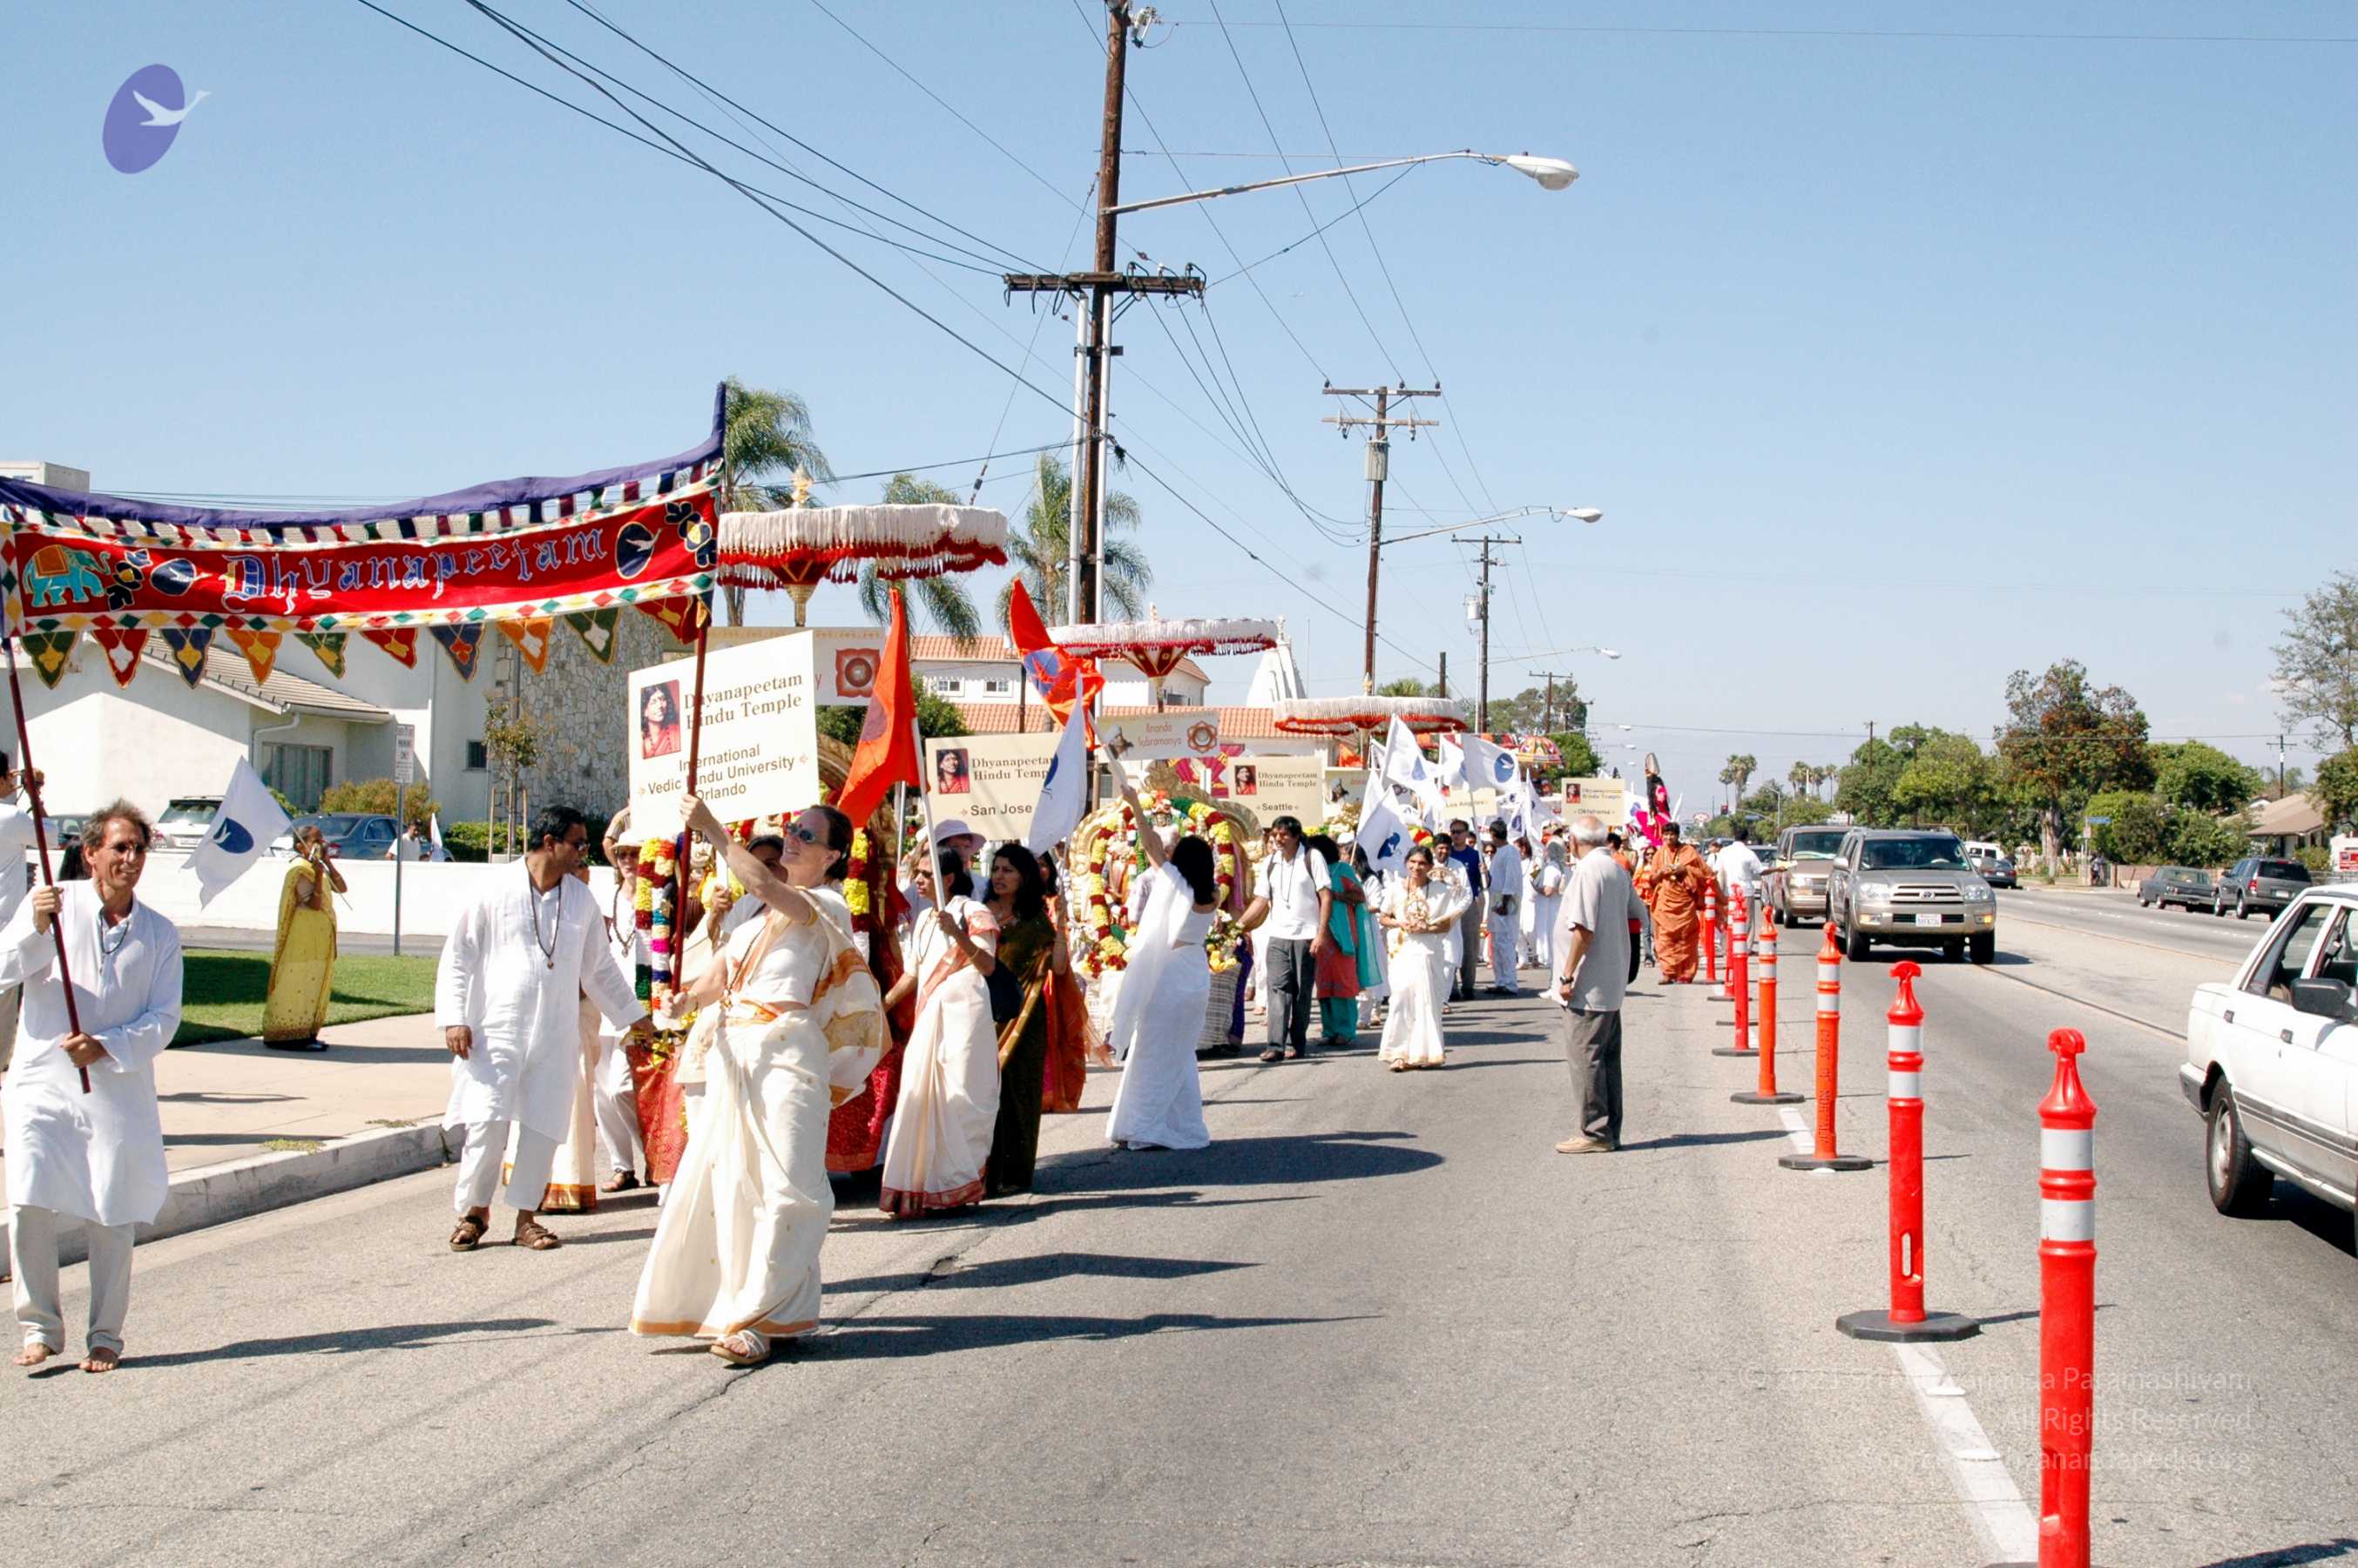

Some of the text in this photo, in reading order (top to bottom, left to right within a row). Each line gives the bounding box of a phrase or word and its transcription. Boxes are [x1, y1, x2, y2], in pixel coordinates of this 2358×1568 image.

[220, 527, 607, 614] Dhyanapeetam
[685, 673, 802, 709] Dyanapeetam
[740, 694, 802, 718] Temple
[679, 744, 760, 772] Inernational
[972, 755, 1053, 769] Dhyanapeeta
[648, 778, 681, 795] Vedic
[727, 757, 794, 779] University
[974, 770, 1010, 781] Hindu
[1258, 771, 1318, 780] Dhyanapeetam
[696, 782, 747, 801] Orlando
[1287, 780, 1317, 788] Temple
[970, 803, 1032, 816] San Jose
[1261, 802, 1294, 811] Seattle
